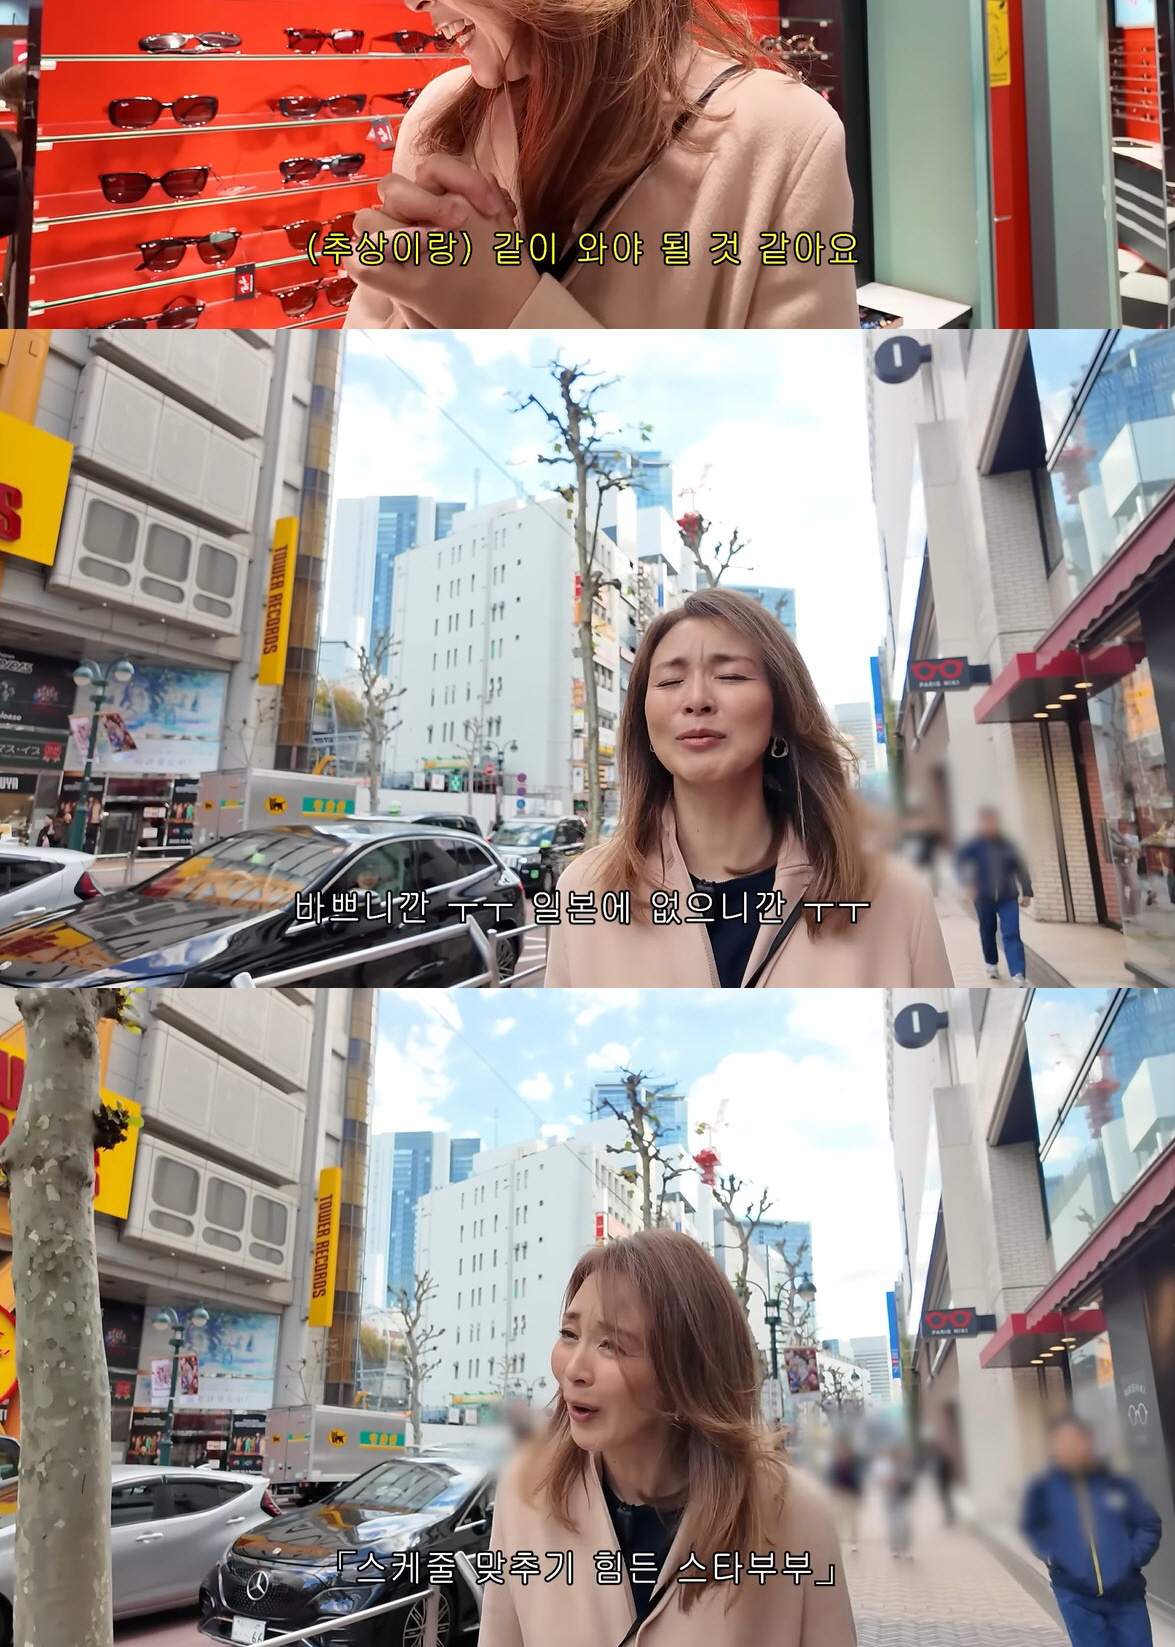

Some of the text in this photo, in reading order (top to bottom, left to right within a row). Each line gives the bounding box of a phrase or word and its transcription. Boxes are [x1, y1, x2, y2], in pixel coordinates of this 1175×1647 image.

[263, 544, 288, 655] TOWER RECORDS
[0, 711, 22, 722] lease
[312, 1194, 333, 1298] TOWER RECORDS
